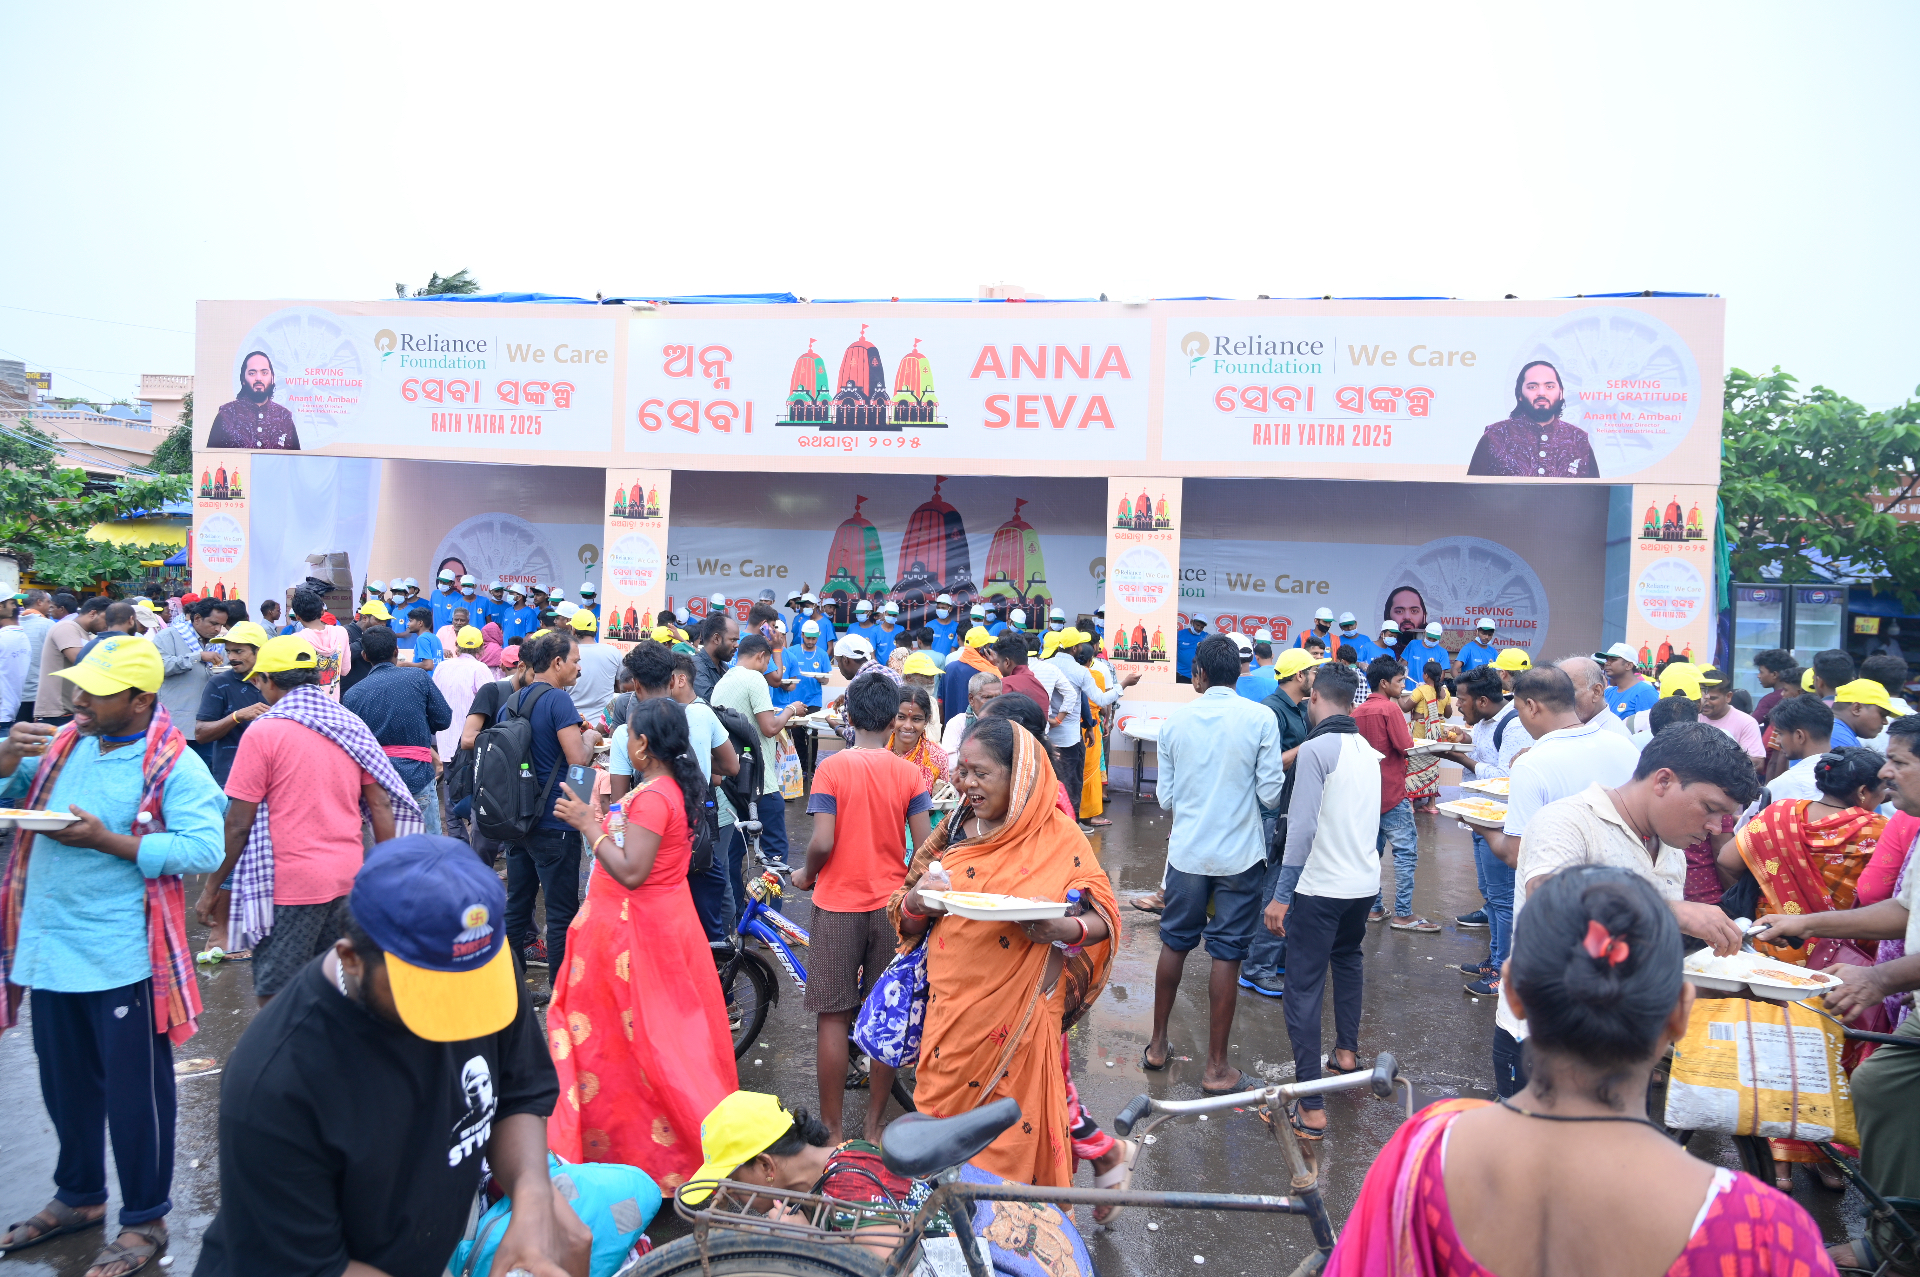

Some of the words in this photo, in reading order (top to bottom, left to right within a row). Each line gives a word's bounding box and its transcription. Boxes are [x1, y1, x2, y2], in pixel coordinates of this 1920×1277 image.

[400, 333, 487, 353] Reliance
[1213, 335, 1324, 356] Reliance
[400, 354, 486, 369] Foundation
[506, 343, 546, 363] We
[553, 343, 609, 364] Care
[969, 345, 1132, 379] ANNA
[1348, 344, 1397, 367] We
[1407, 344, 1477, 367] Care
[305, 368, 344, 377] SERVING
[662, 344, 734, 390] ଅନ୍ନ
[1213, 358, 1322, 374] Foundation
[285, 377, 309, 386] WITH
[312, 378, 363, 387] GRATITUDE
[401, 378, 480, 403] ସେବା
[1606, 380, 1661, 389] SERVING
[288, 394, 313, 402] Anant
[314, 395, 325, 403] M.
[327, 395, 358, 404] Ambani
[1214, 385, 1314, 413] ସେବା
[1578, 391, 1612, 401] WITH
[1616, 392, 1688, 402] GRATITUDE
[637, 398, 753, 435] ସେବା
[983, 394, 1116, 429] SEVA
[1583, 411, 1617, 420] Anant
[1620, 412, 1635, 421] M.
[1638, 412, 1682, 421] Ambani
[431, 412, 462, 433] RATH
[467, 413, 505, 434] YATRA
[510, 414, 542, 435] 2025
[797, 435, 859, 451] ରଥଯାତ୍ରା
[868, 436, 922, 449] ୨୦୨୫
[1252, 423, 1291, 446] RATH
[1298, 423, 1345, 446] YATRA
[1352, 424, 1392, 447] 2025
[696, 557, 732, 576] We
[739, 559, 789, 579] Care
[498, 574, 537, 583] SERVING
[1226, 572, 1266, 592] We
[1274, 574, 1330, 594] Care
[1440, 616, 1470, 626] WITH
[1465, 606, 1514, 616] SERVING
[1492, 637, 1531, 647] Ambani
[768, 942, 806, 995] HERCU
